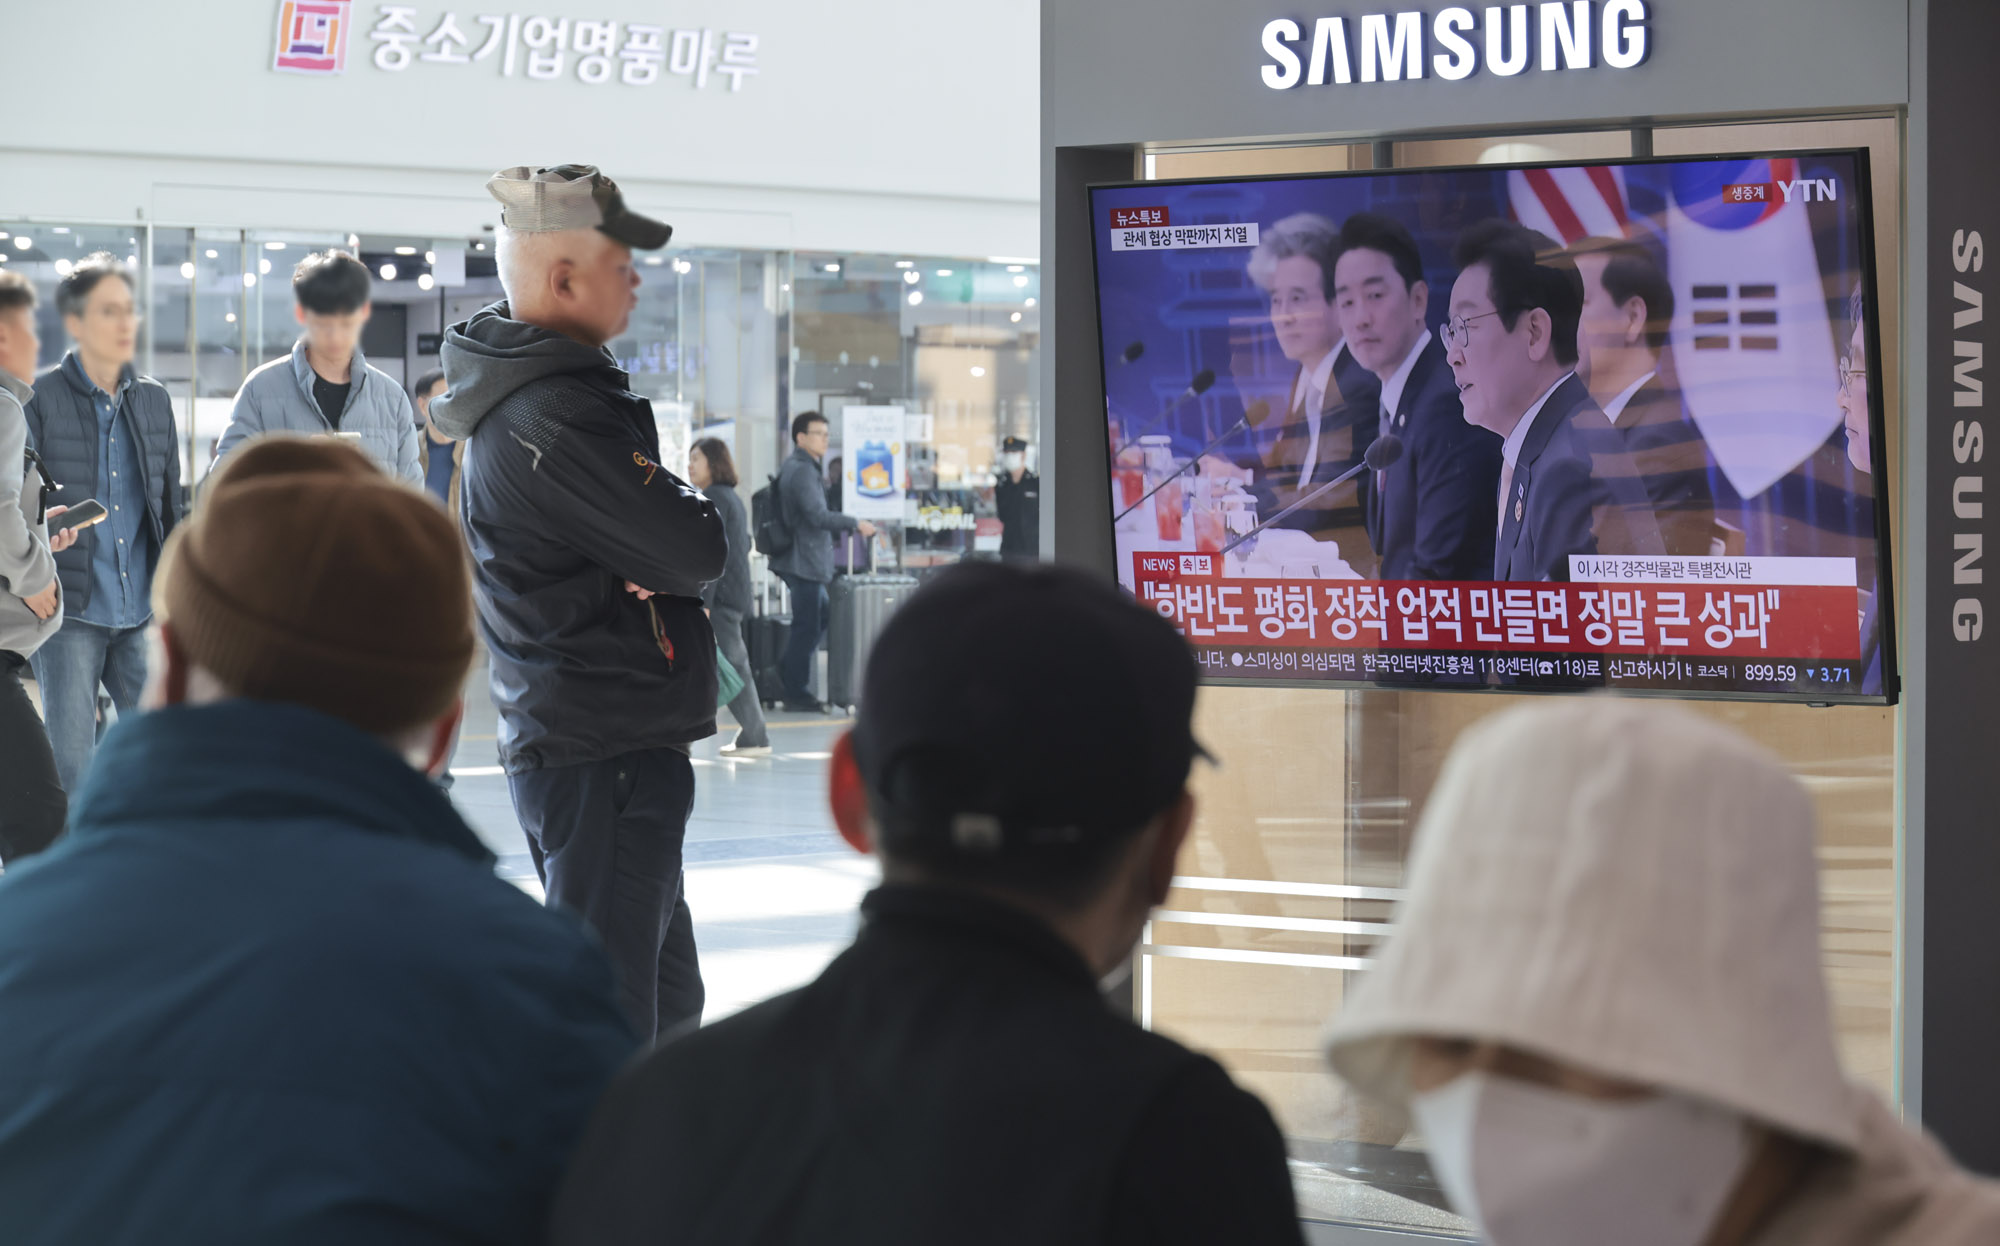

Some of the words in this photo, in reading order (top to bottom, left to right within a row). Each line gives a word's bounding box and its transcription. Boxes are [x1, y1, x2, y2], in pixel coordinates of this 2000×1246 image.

[369, 4, 761, 93] 중소기업명품마루
[1261, 0, 1647, 90] SAMSUNG
[1732, 185, 1764, 201] 생중계
[1777, 178, 1837, 203] YTN
[1116, 210, 1163, 226] 뉴스특보
[1123, 231, 1147, 247] 관세
[1149, 229, 1172, 247] 협상
[1175, 227, 1221, 245] 막판까지
[1224, 226, 1248, 244] 치열
[1952, 228, 1984, 642] SAMSUNG
[1143, 558, 1176, 571] NEWS
[1182, 558, 1209, 571] 속보
[1577, 560, 1590, 577] 이
[1593, 561, 1619, 577] 시각
[1621, 561, 1684, 579] 경주박물관
[1687, 561, 1752, 580] 특별전시관
[1253, 584, 1318, 640] 평화
[1324, 585, 1389, 642] 정착
[1397, 586, 1464, 643] 업적
[1470, 588, 1571, 645] 만들면
[1578, 589, 1646, 647] 정말
[1654, 592, 1690, 647] 큰
[1697, 588, 1780, 649] 성과"
[1192, 650, 1228, 668] 니다.
[1301, 653, 1356, 672] 의심되면
[1362, 654, 1475, 675] 한국인터넷진흥원
[1608, 659, 1681, 681] 신고하시기
[1697, 664, 1728, 679] 코스닥
[1745, 664, 1796, 682] 899.59
[1820, 667, 1851, 683] 3.71
